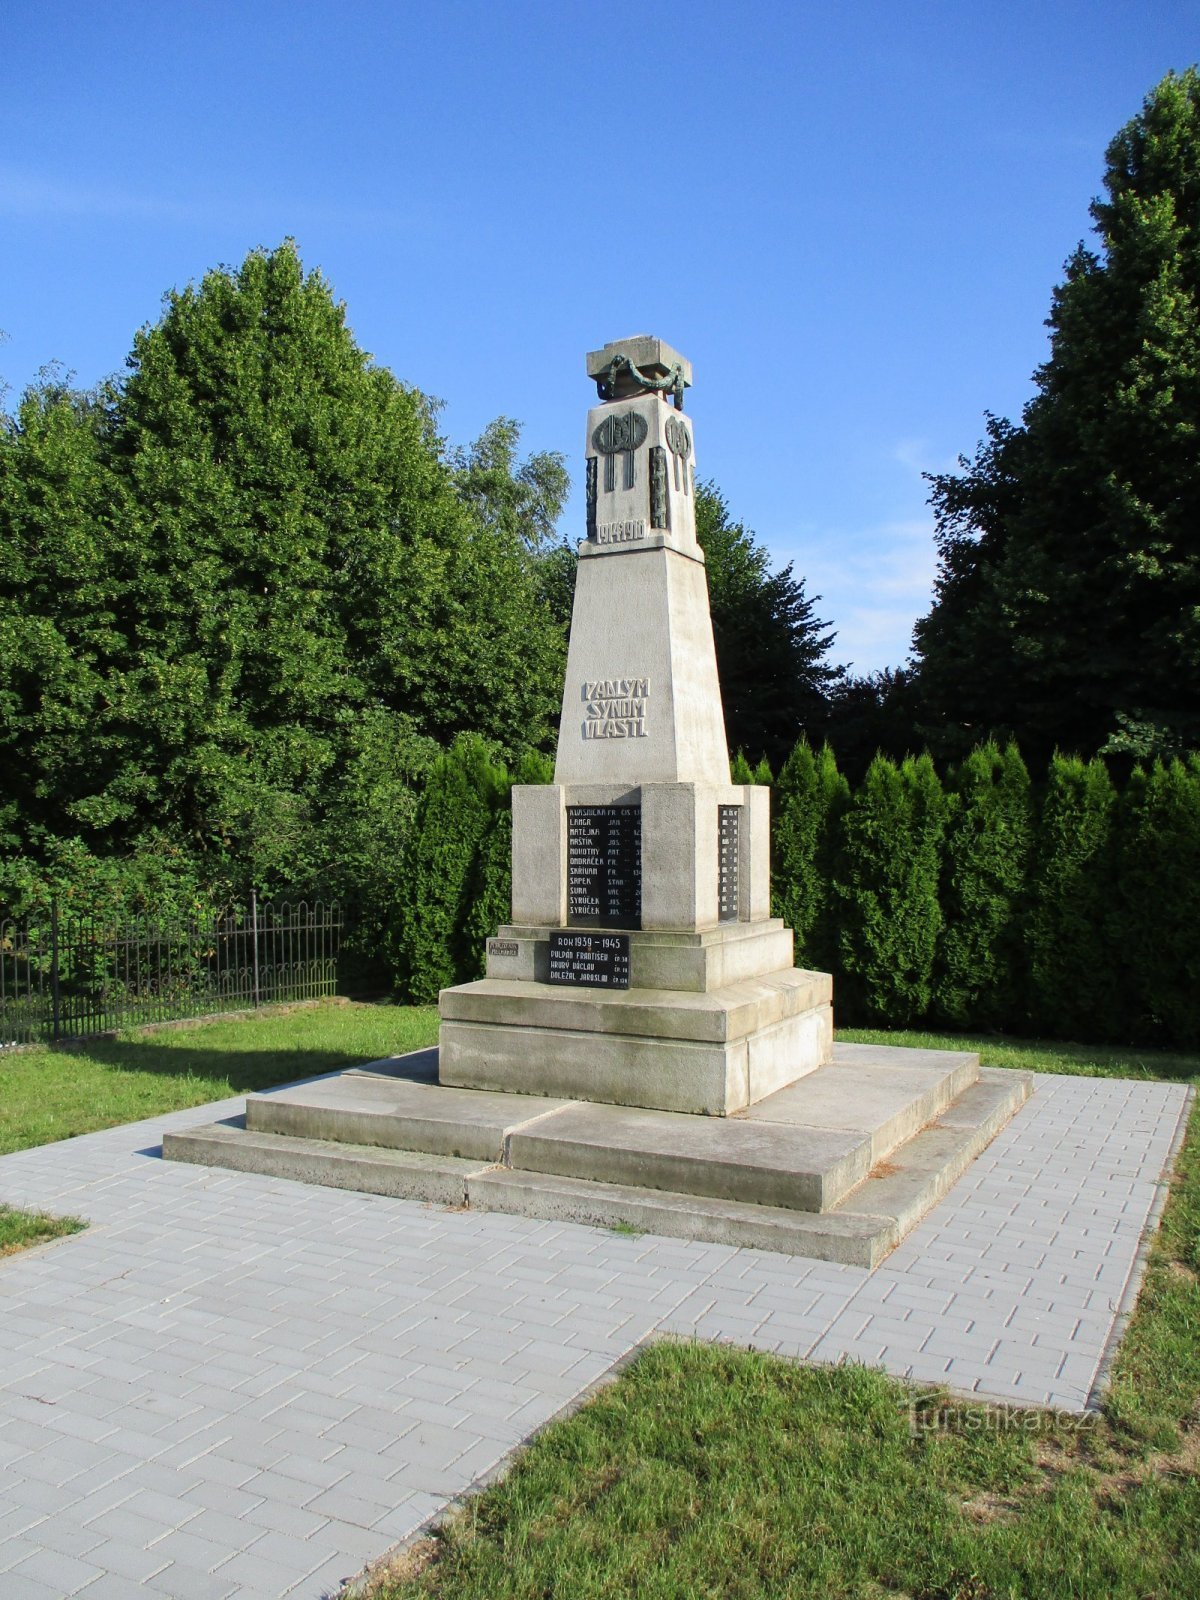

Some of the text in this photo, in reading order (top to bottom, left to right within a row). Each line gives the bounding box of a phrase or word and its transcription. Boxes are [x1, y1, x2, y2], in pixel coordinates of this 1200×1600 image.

[569, 856, 604, 865] ONDRÁČEK
[558, 938, 573, 946] ROK
[574, 937, 592, 947] 1939
[602, 938, 621, 949] 1945
[576, 950, 609, 961] FRANTIŠEK
[572, 960, 595, 971] VÁCLAV
[550, 971, 576, 981] DOLEŽAL
[579, 973, 608, 983] JAROSLAV
